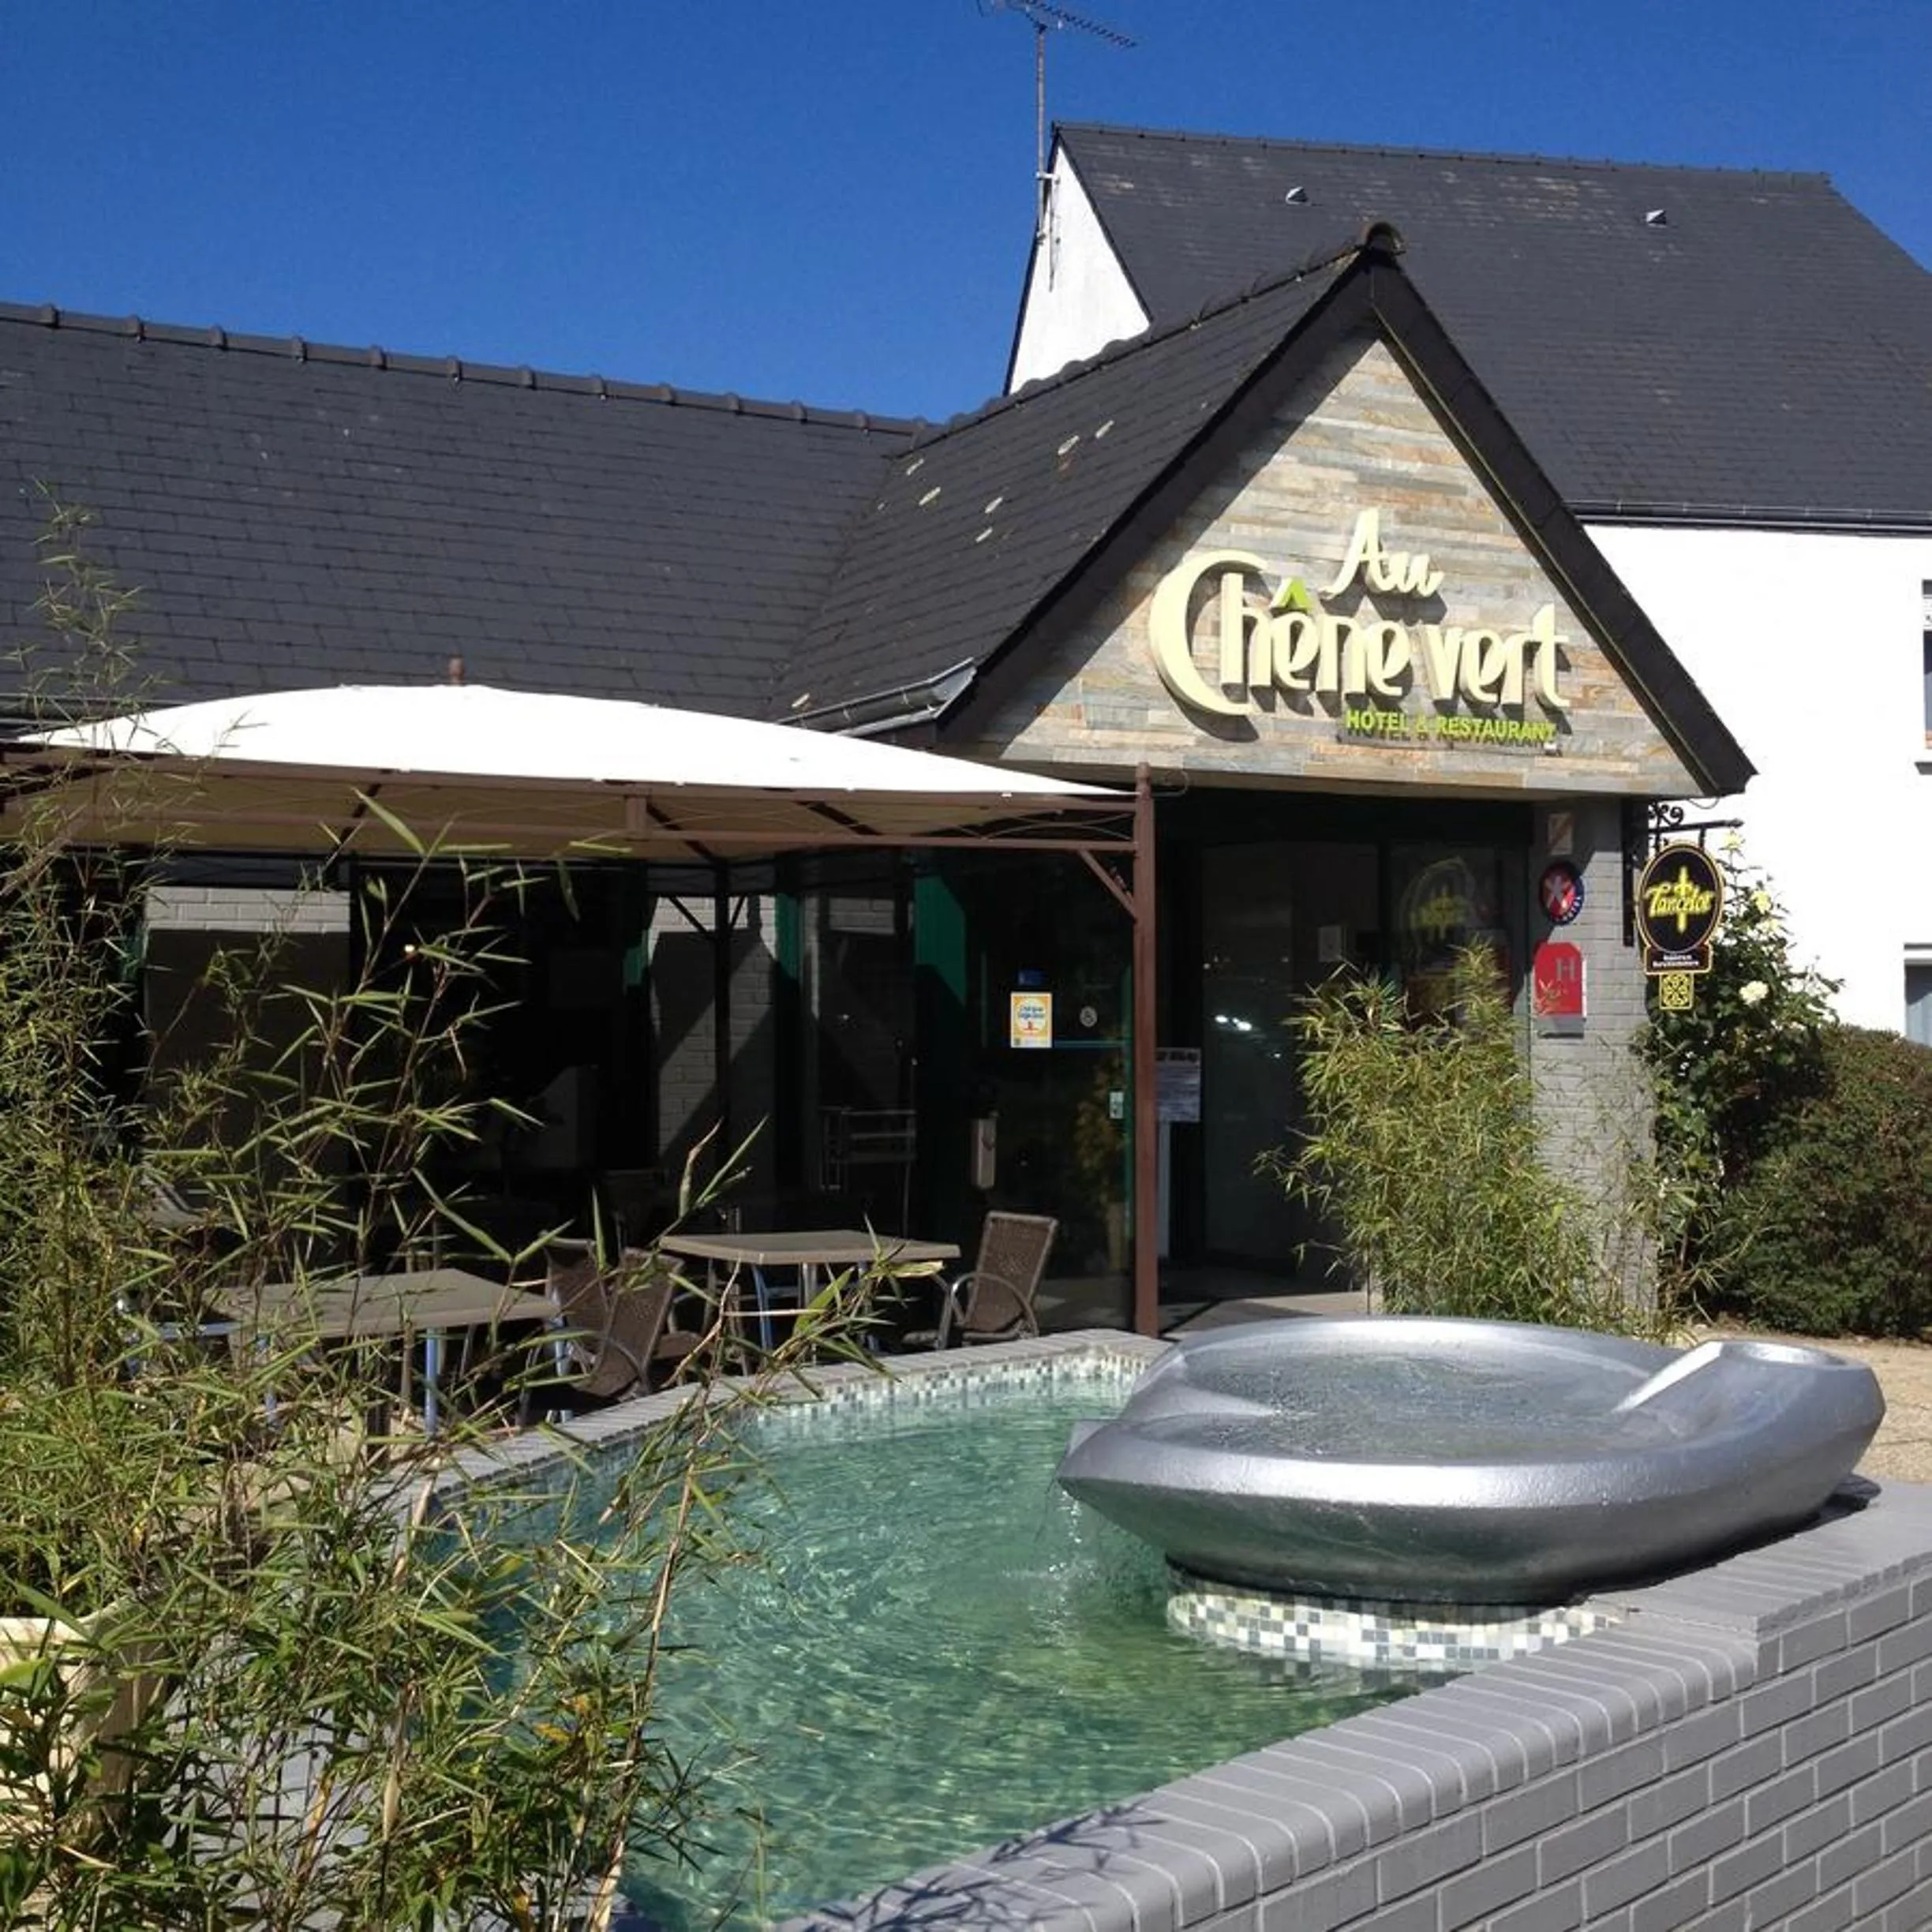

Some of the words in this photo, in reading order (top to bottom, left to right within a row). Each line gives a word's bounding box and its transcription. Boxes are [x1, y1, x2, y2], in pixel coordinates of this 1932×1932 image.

[1320, 507, 1444, 597] Au
[1148, 549, 1410, 716] Chêne
[1425, 603, 1570, 708] vert
[1434, 717, 1557, 741] RESTAURANT
